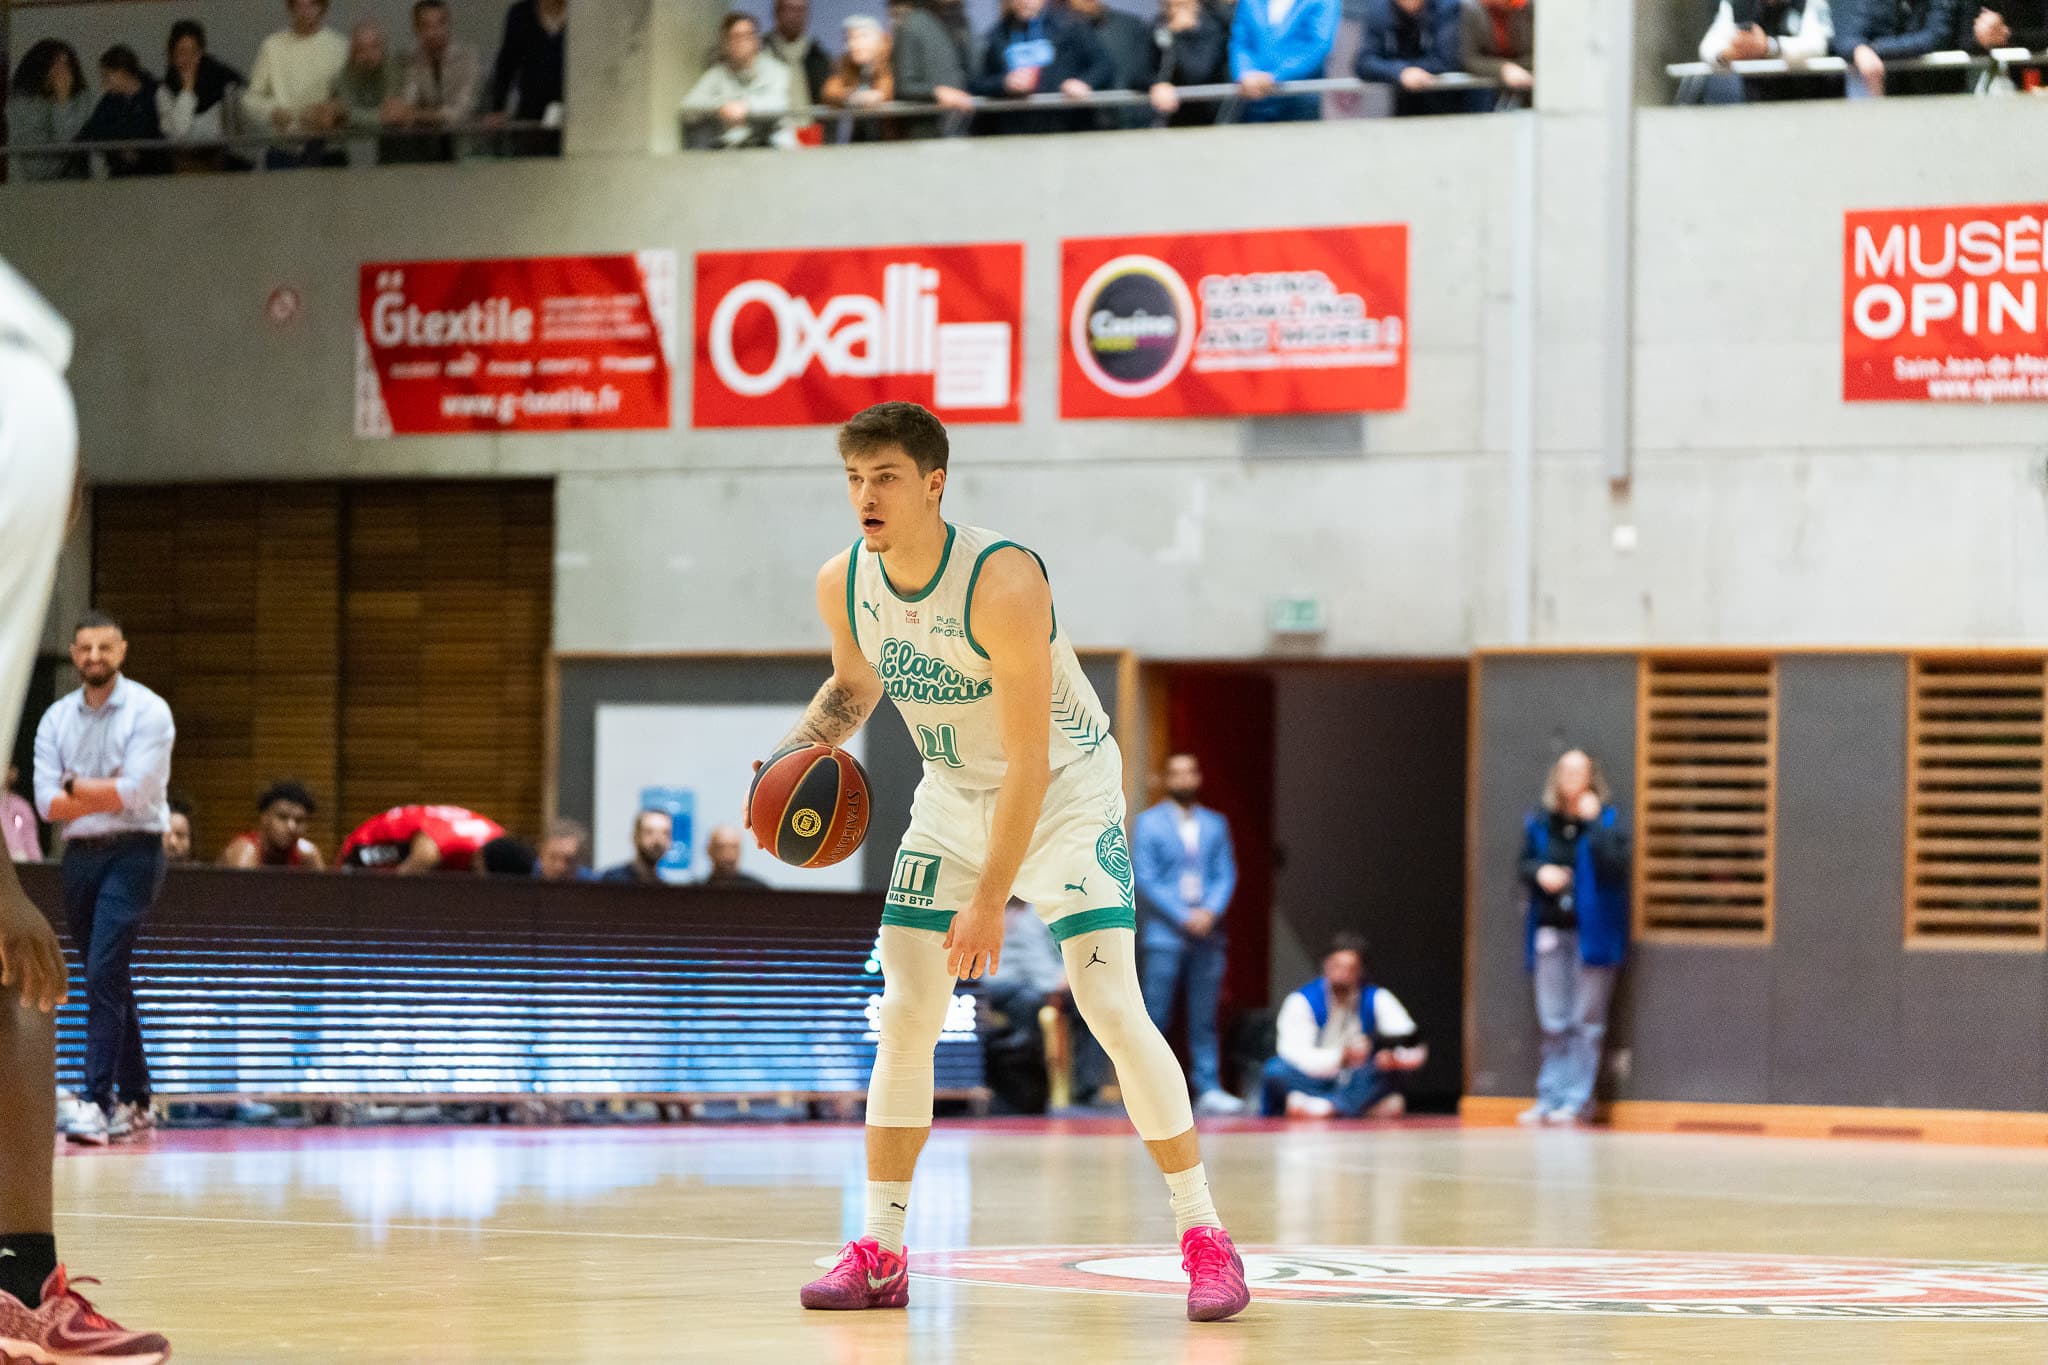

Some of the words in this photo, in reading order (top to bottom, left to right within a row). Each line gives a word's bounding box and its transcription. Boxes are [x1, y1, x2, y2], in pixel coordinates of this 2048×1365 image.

[709, 262, 939, 397] Oxalli
[1853, 280, 2048, 340] OPIN
[917, 724, 965, 768] 4
[909, 895, 933, 906] BTP
